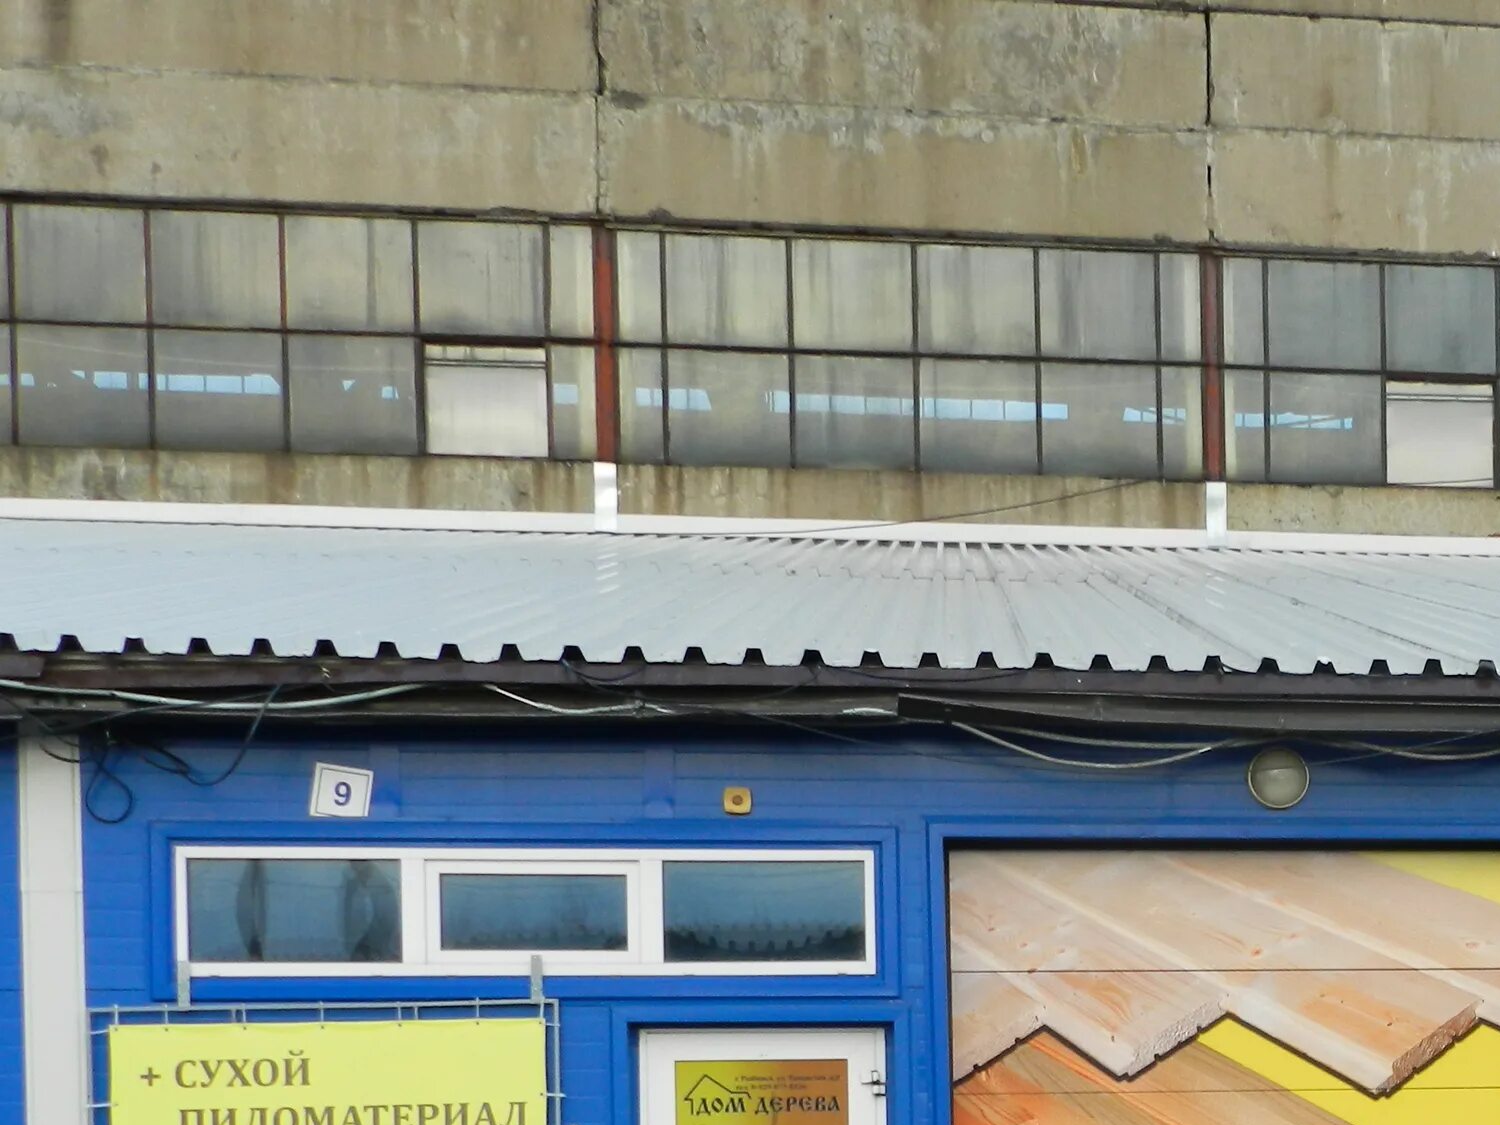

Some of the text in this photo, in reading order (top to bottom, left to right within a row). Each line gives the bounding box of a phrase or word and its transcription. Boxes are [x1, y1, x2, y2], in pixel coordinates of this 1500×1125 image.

[334, 781, 352, 806] 9
[174, 1050, 312, 1089] СУХОЙ
[696, 1097, 746, 1116] ДОМ
